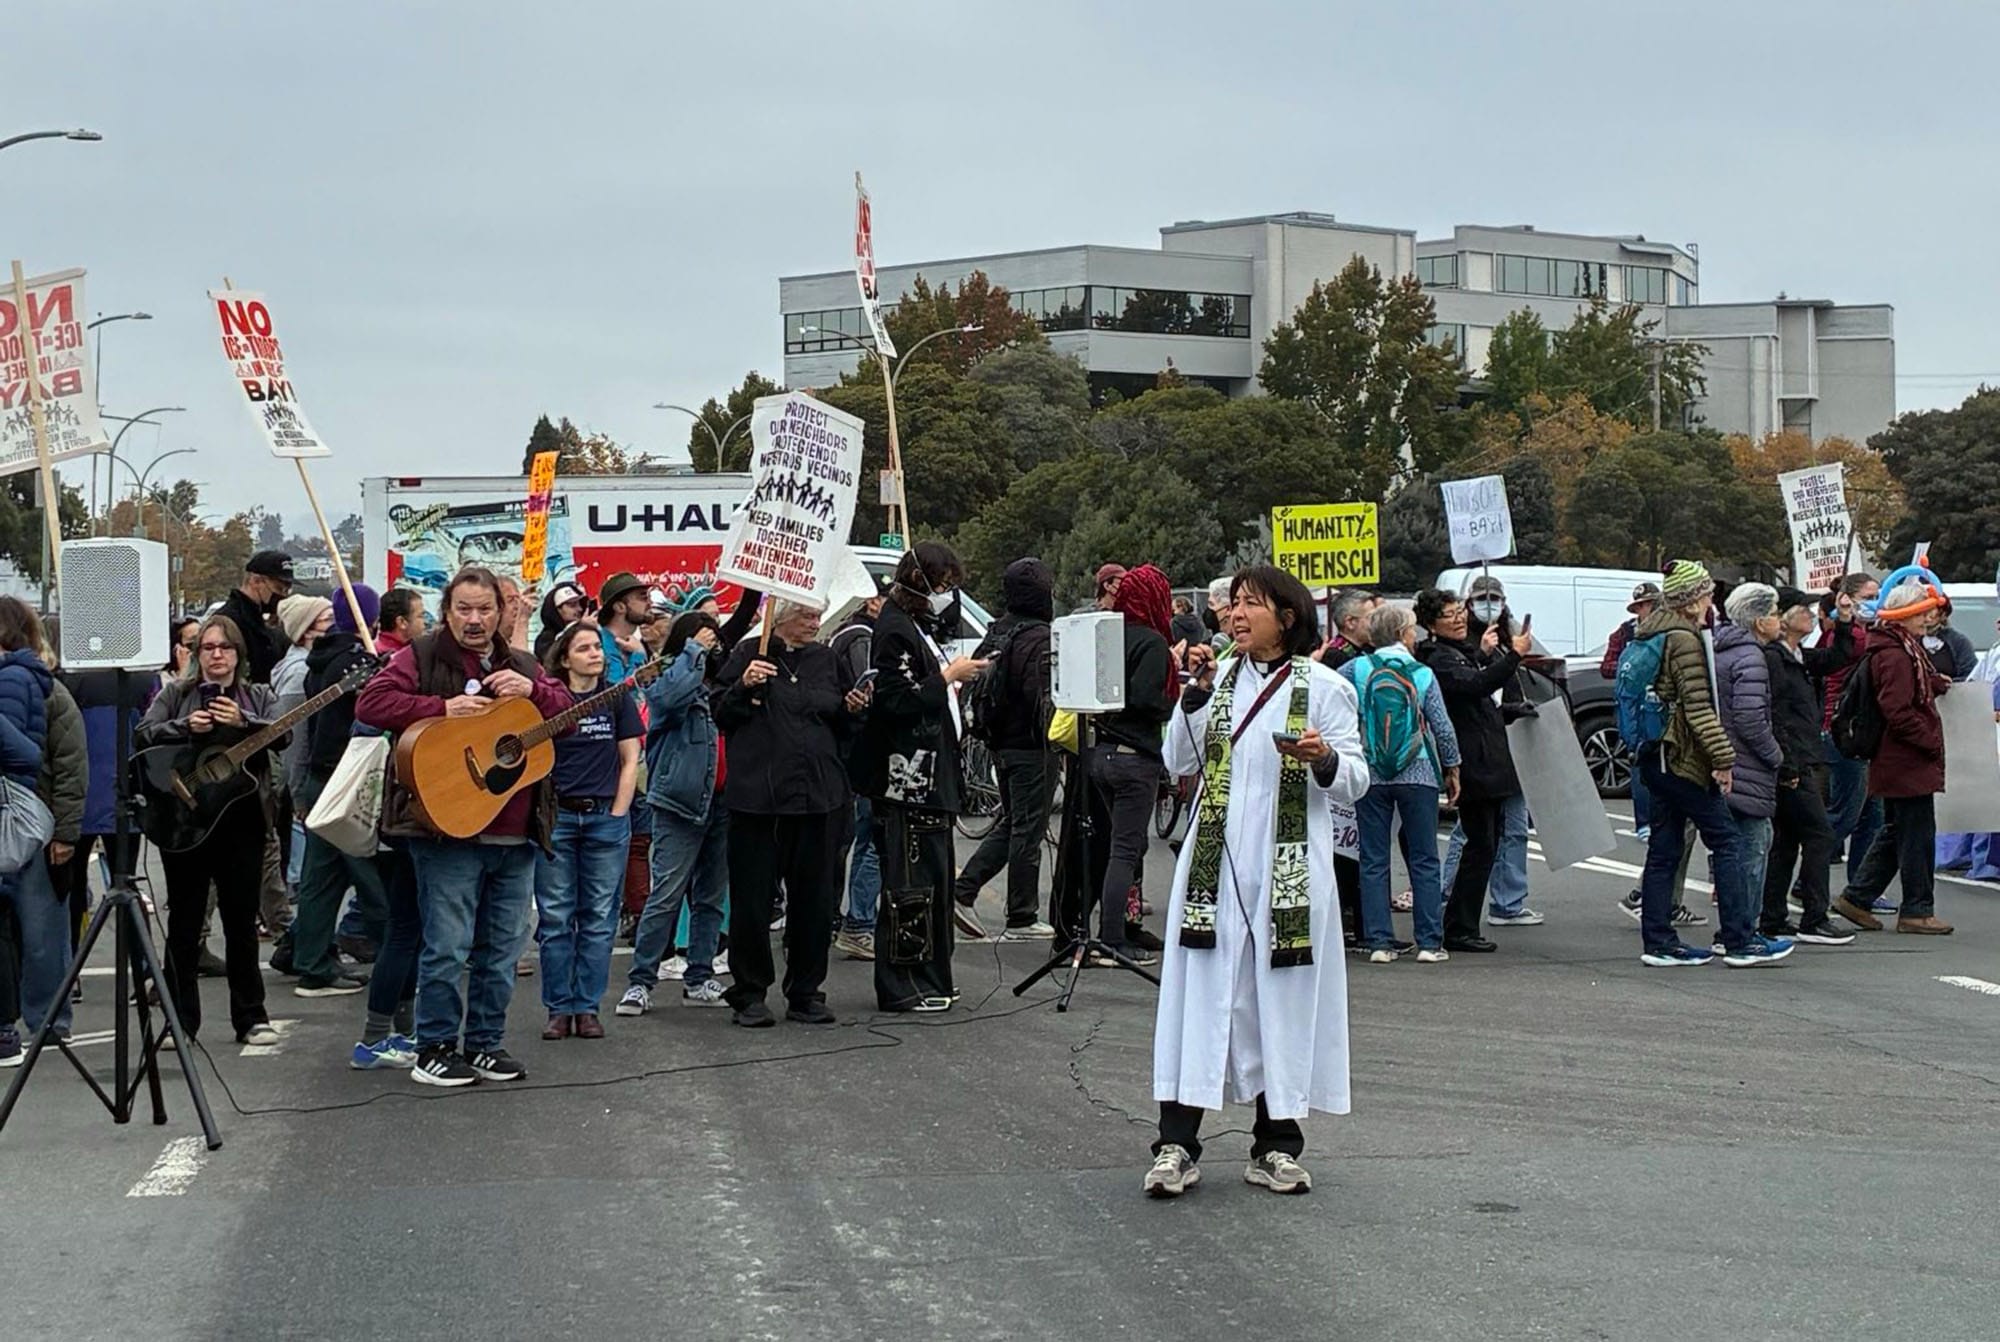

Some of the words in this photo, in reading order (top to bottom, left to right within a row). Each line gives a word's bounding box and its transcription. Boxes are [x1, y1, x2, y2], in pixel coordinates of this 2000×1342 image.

[217, 299, 272, 337] NO
[242, 378, 298, 403] BAY!
[785, 401, 829, 428] PROTECT
[789, 419, 848, 452] NEIGHBORS
[808, 460, 852, 487] VECINOS
[756, 527, 808, 555] TOGETHER
[775, 516, 824, 543] FAMILIES
[743, 541, 814, 573] MANTENIENDO
[1280, 553, 1296, 568] BE
[1298, 549, 1374, 580] MENSCH
[732, 555, 776, 579] FAMILIAS
[779, 567, 816, 591] UNIDAS
